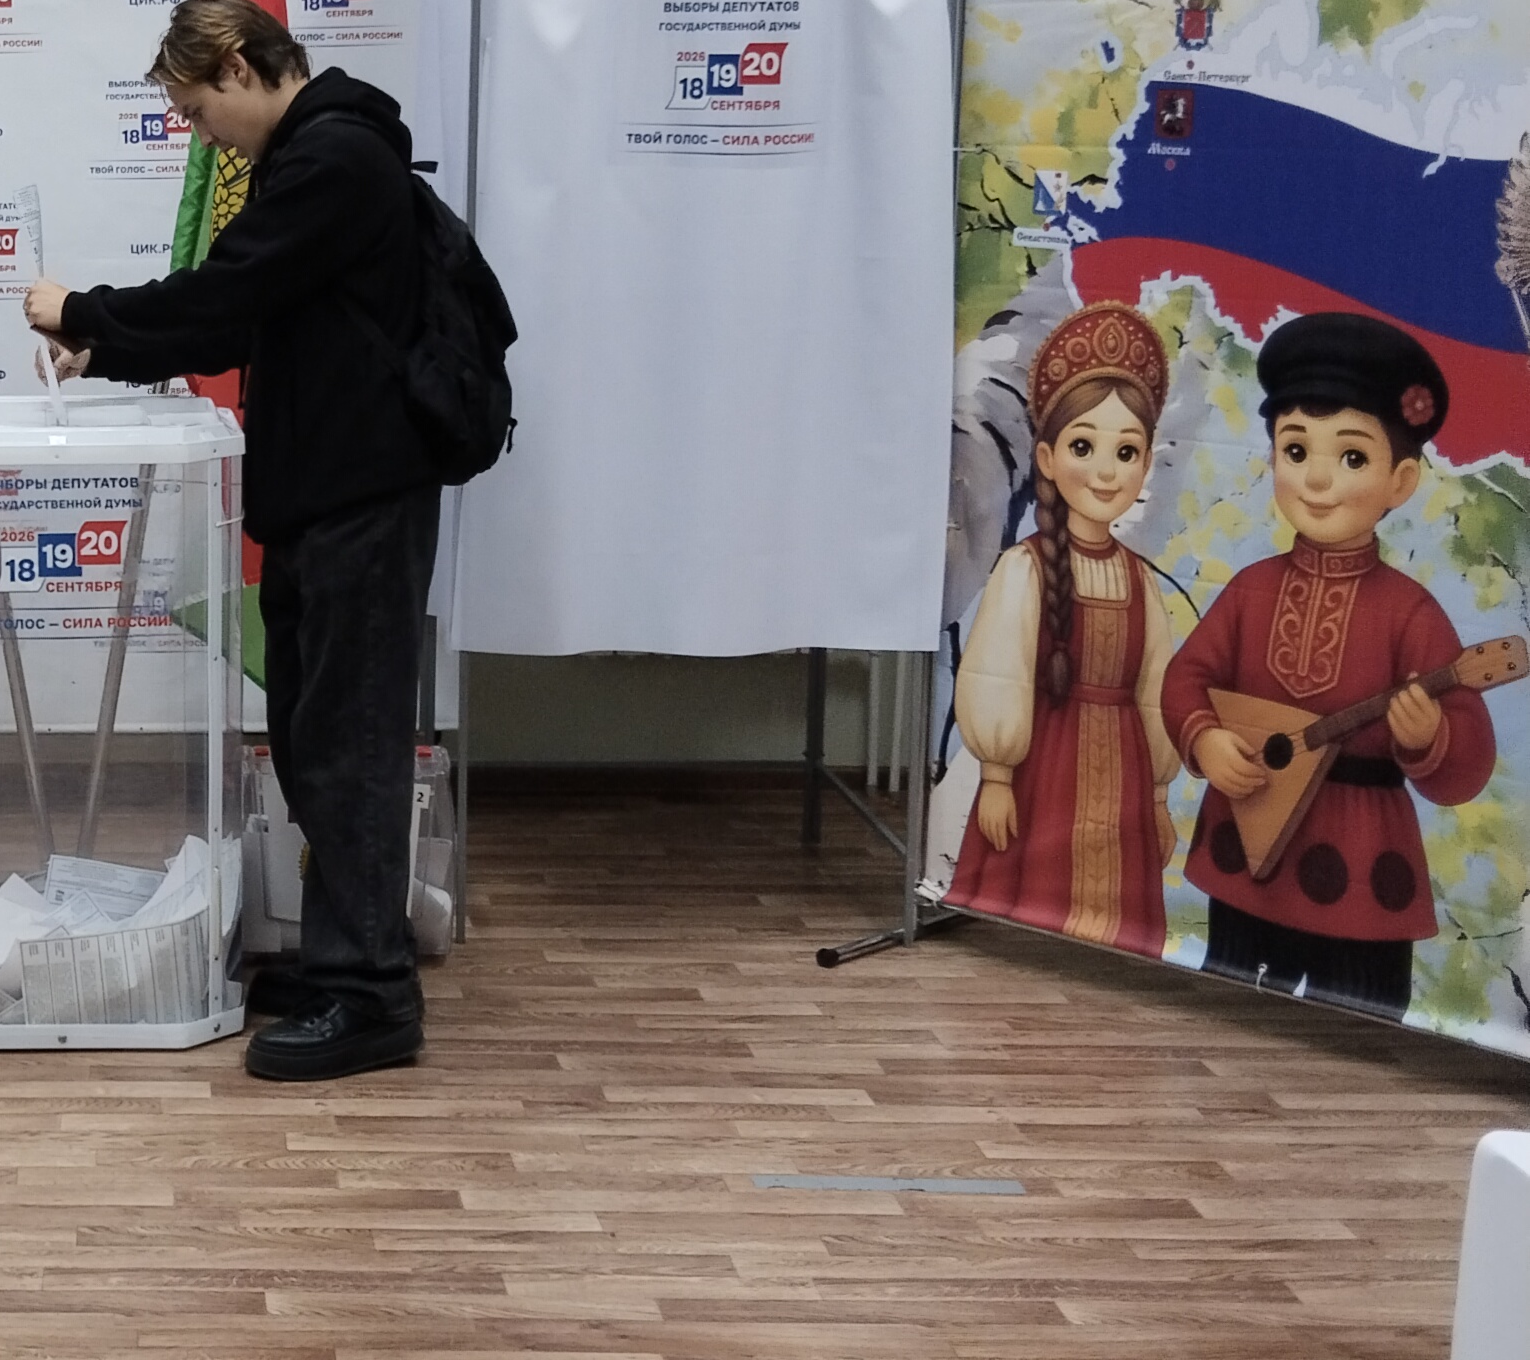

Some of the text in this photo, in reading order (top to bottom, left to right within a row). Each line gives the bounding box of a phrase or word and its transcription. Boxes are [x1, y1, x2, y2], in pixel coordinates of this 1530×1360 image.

[664, 1, 799, 13] ВЫБОРЫ ДЕПУТАТОВ
[326, 10, 373, 18] СЕНТЯБРЯ
[659, 20, 801, 31] ГОСУДАРСТВЕННОЙ ДУМЫ
[677, 52, 705, 61] 2026
[679, 52, 779, 99] 18 19 20
[711, 100, 780, 110] СЕНТЯБРЯ
[122, 130, 139, 144] 18
[144, 120, 162, 135] 19
[626, 132, 814, 145] ТВОЙ ГОЛОС СИЛА РОССИИ!
[90, 165, 114, 174] ТВОЙ
[51, 478, 139, 491] ДЕПУТАТОВ
[105, 499, 142, 509] ДУМЫ
[1, 532, 34, 541] 2026
[6, 531, 118, 582] 18 19 20
[46, 581, 122, 593] СЕНТЯБРЯ
[63, 618, 105, 629] СИЛА
[107, 615, 172, 628] РОССИИ!
[417, 792, 424, 802] 2
